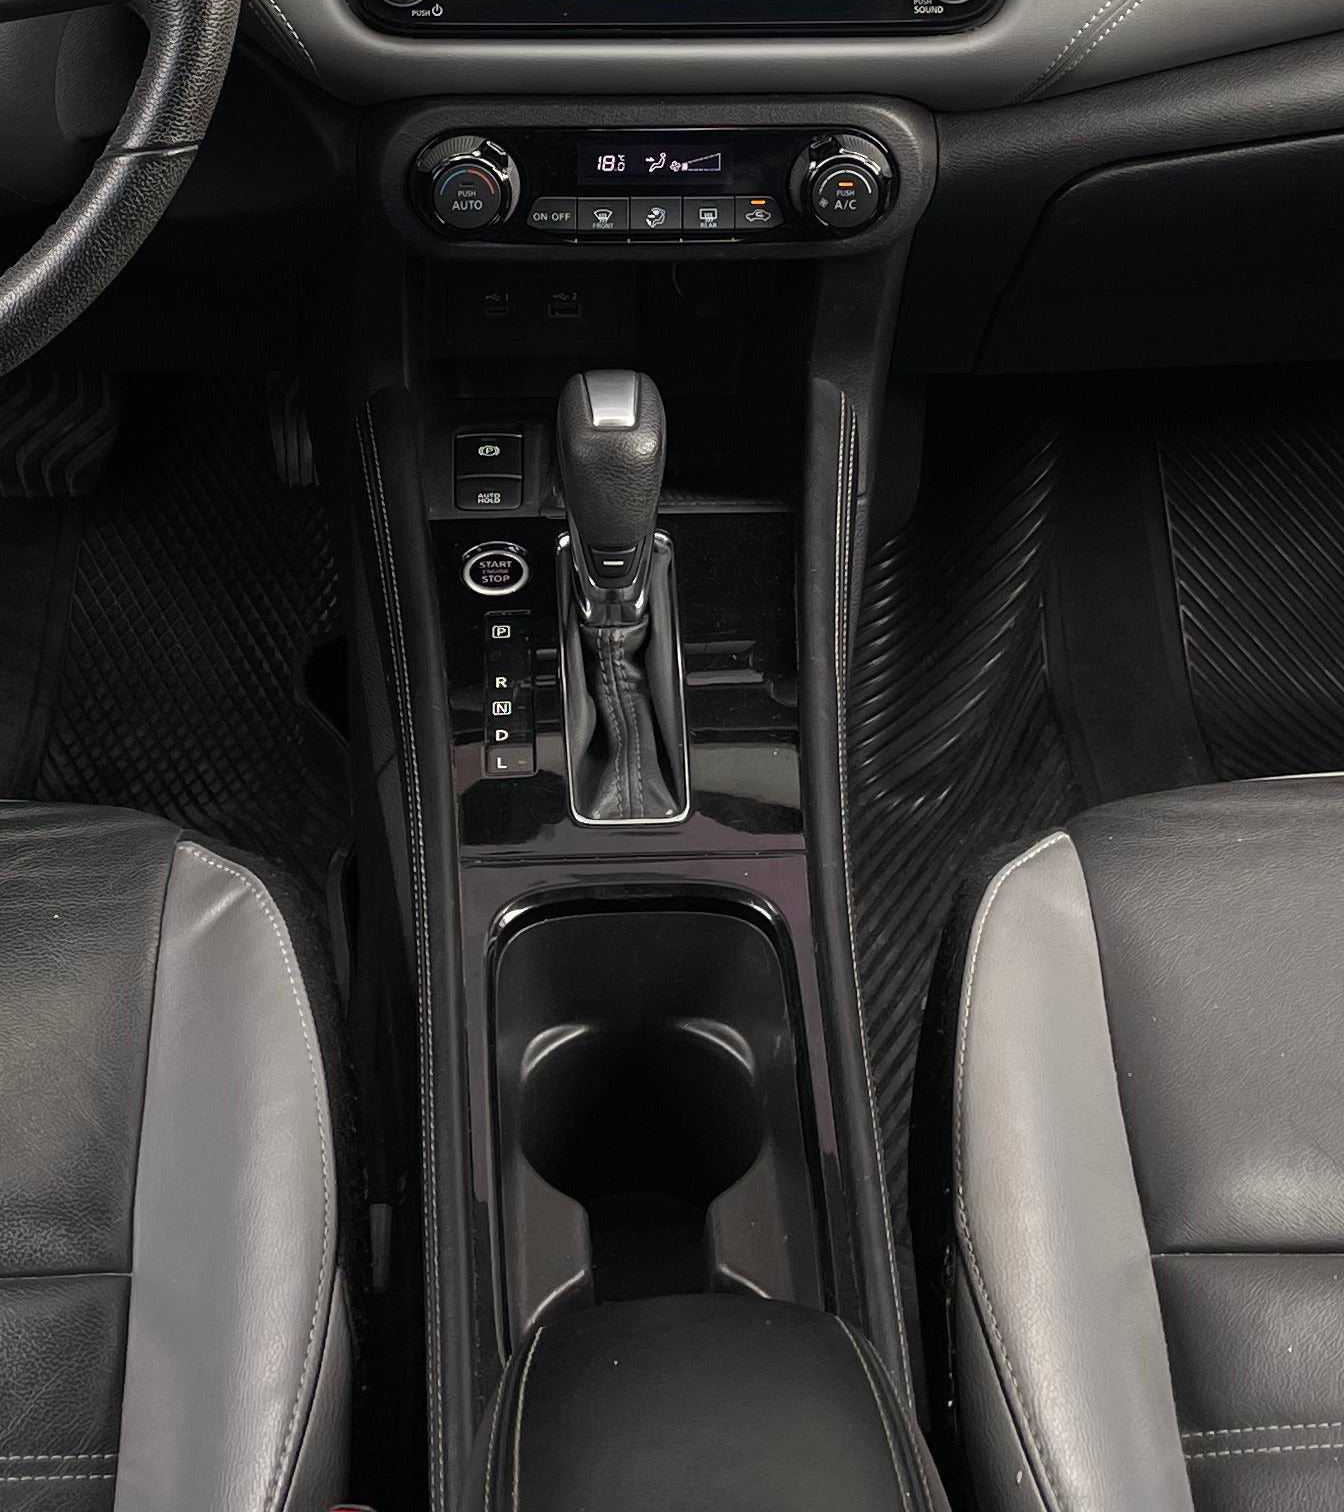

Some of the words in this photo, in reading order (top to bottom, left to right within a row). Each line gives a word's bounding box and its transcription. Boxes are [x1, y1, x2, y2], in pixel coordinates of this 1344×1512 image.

[411, 9, 431, 17] PUSH
[913, 5, 944, 14] SOUND
[457, 190, 477, 198] PUSH
[836, 189, 855, 197] PUSH
[452, 200, 484, 211] AUTO
[833, 199, 857, 211] A/C
[532, 212, 548, 221] ON
[551, 212, 571, 221] OFF
[479, 560, 513, 568] START
[481, 574, 511, 583] STOP
[495, 676, 508, 689] R
[495, 729, 509, 742] D
[496, 757, 508, 769] L
